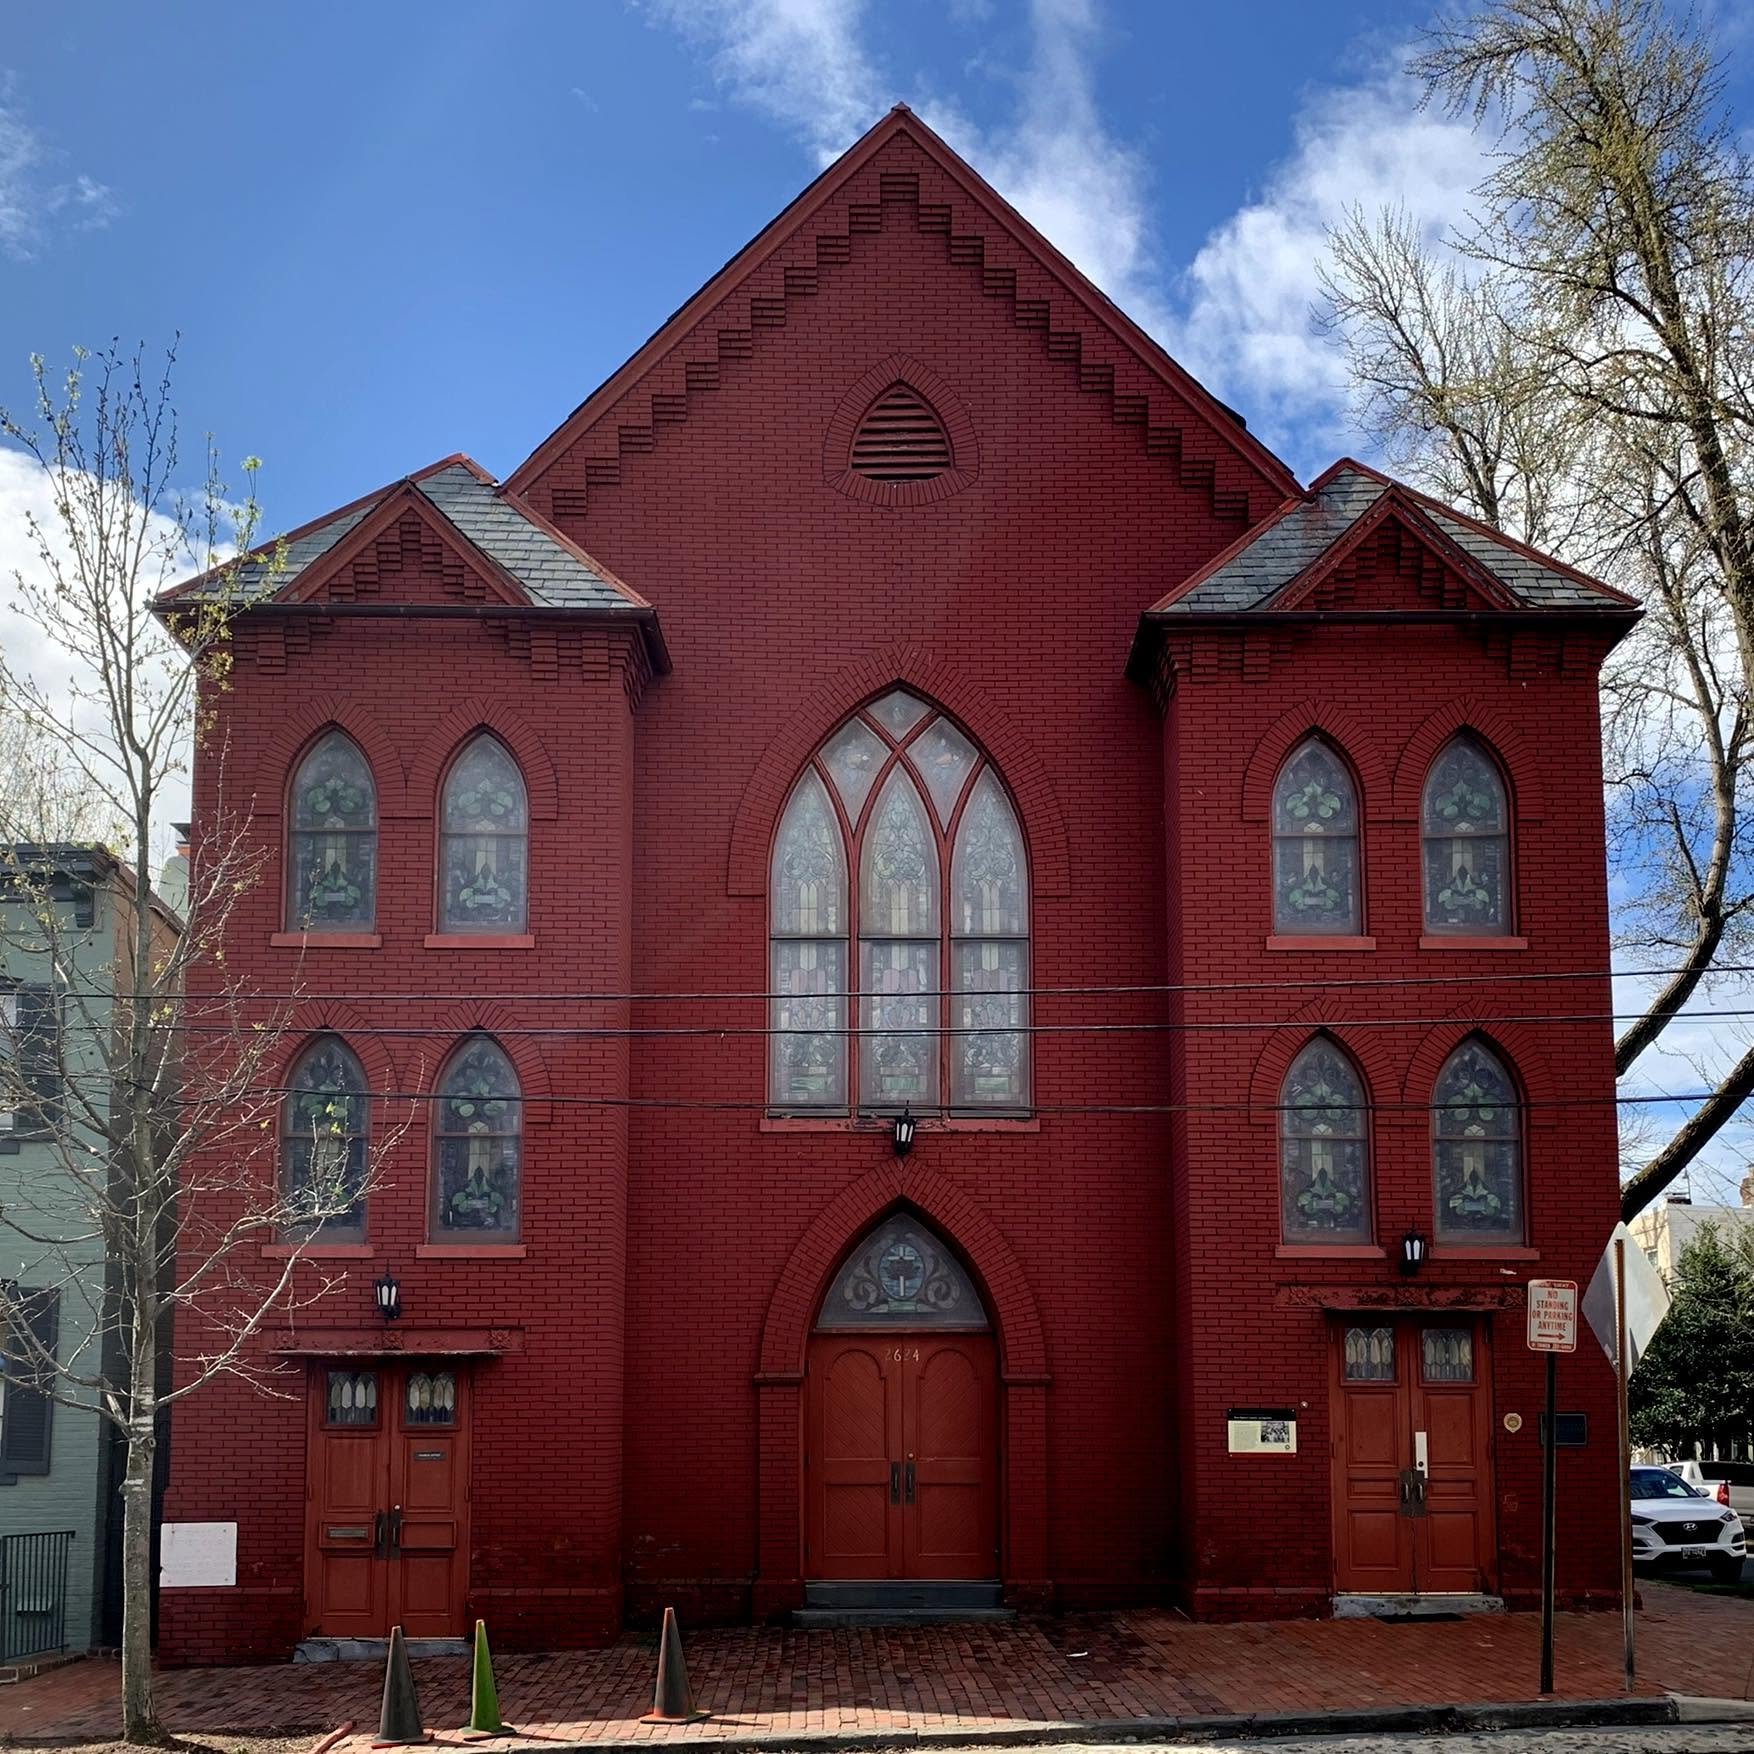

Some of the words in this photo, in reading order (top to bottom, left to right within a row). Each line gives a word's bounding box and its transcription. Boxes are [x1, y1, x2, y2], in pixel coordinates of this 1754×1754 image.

[1547, 1290, 1558, 1299] NO
[1536, 1300, 1568, 1310] STANDING
[1532, 1310, 1541, 1319] OR
[1544, 1310, 1573, 1321] PARKING
[1537, 1321, 1566, 1331] ANYTIME
